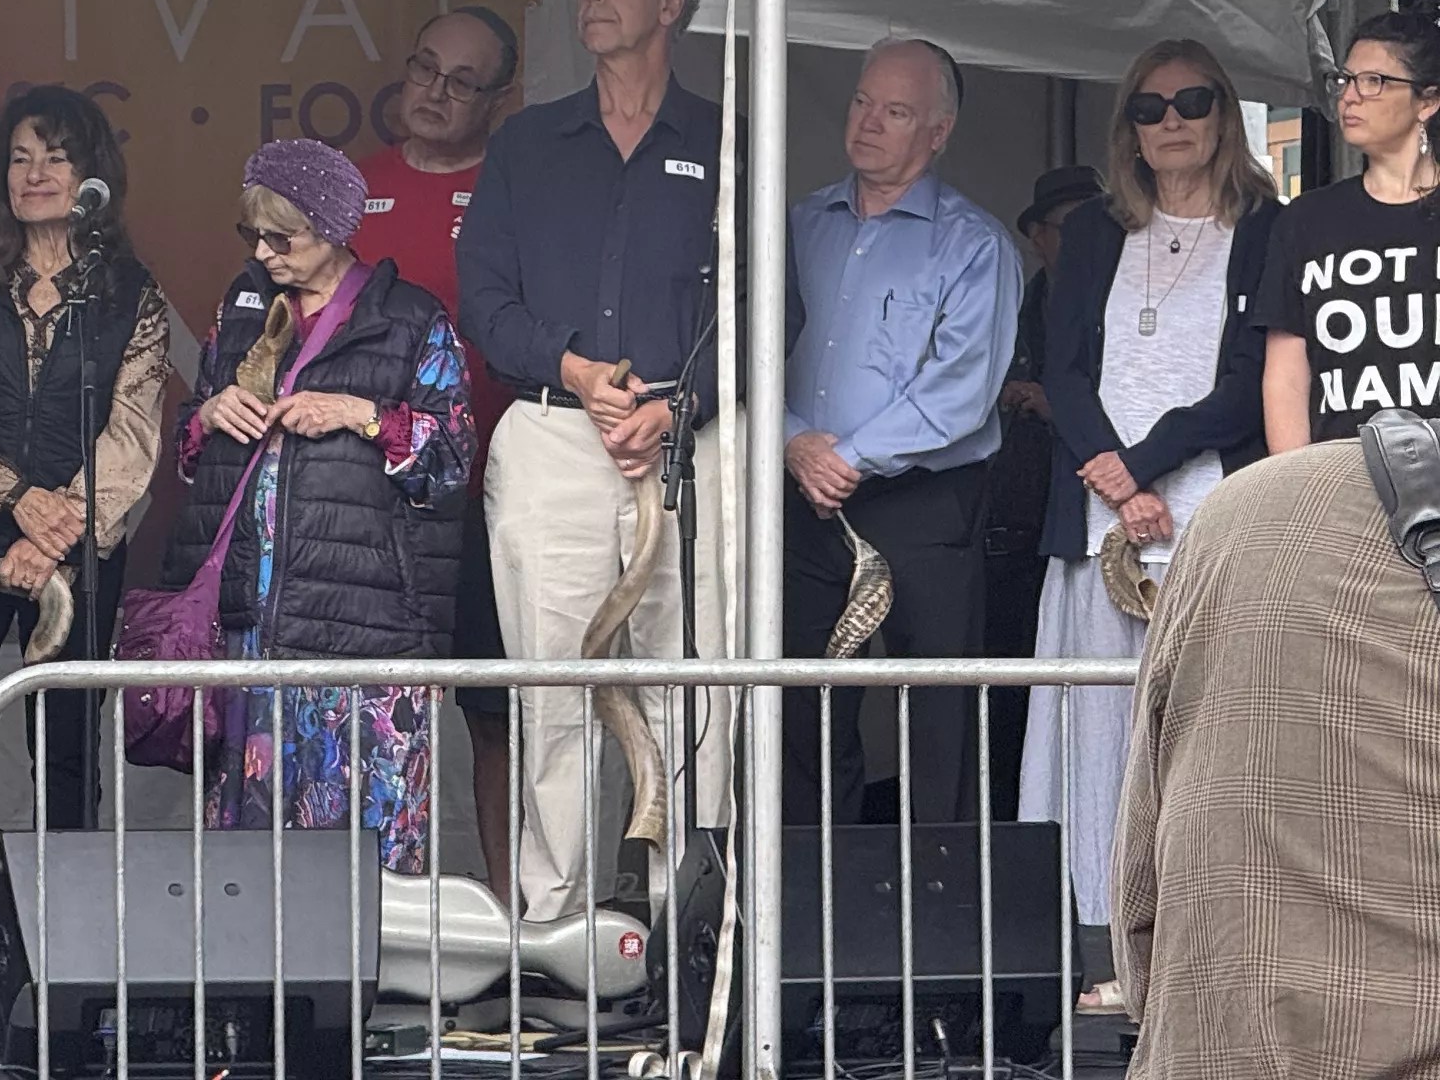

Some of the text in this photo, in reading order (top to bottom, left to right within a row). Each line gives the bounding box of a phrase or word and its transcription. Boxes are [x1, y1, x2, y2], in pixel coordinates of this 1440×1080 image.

[676, 162, 696, 174] 611
[368, 201, 387, 211] 611
[1301, 246, 1418, 295] NOT
[1315, 293, 1440, 354] OU
[1319, 361, 1440, 414] NAM
